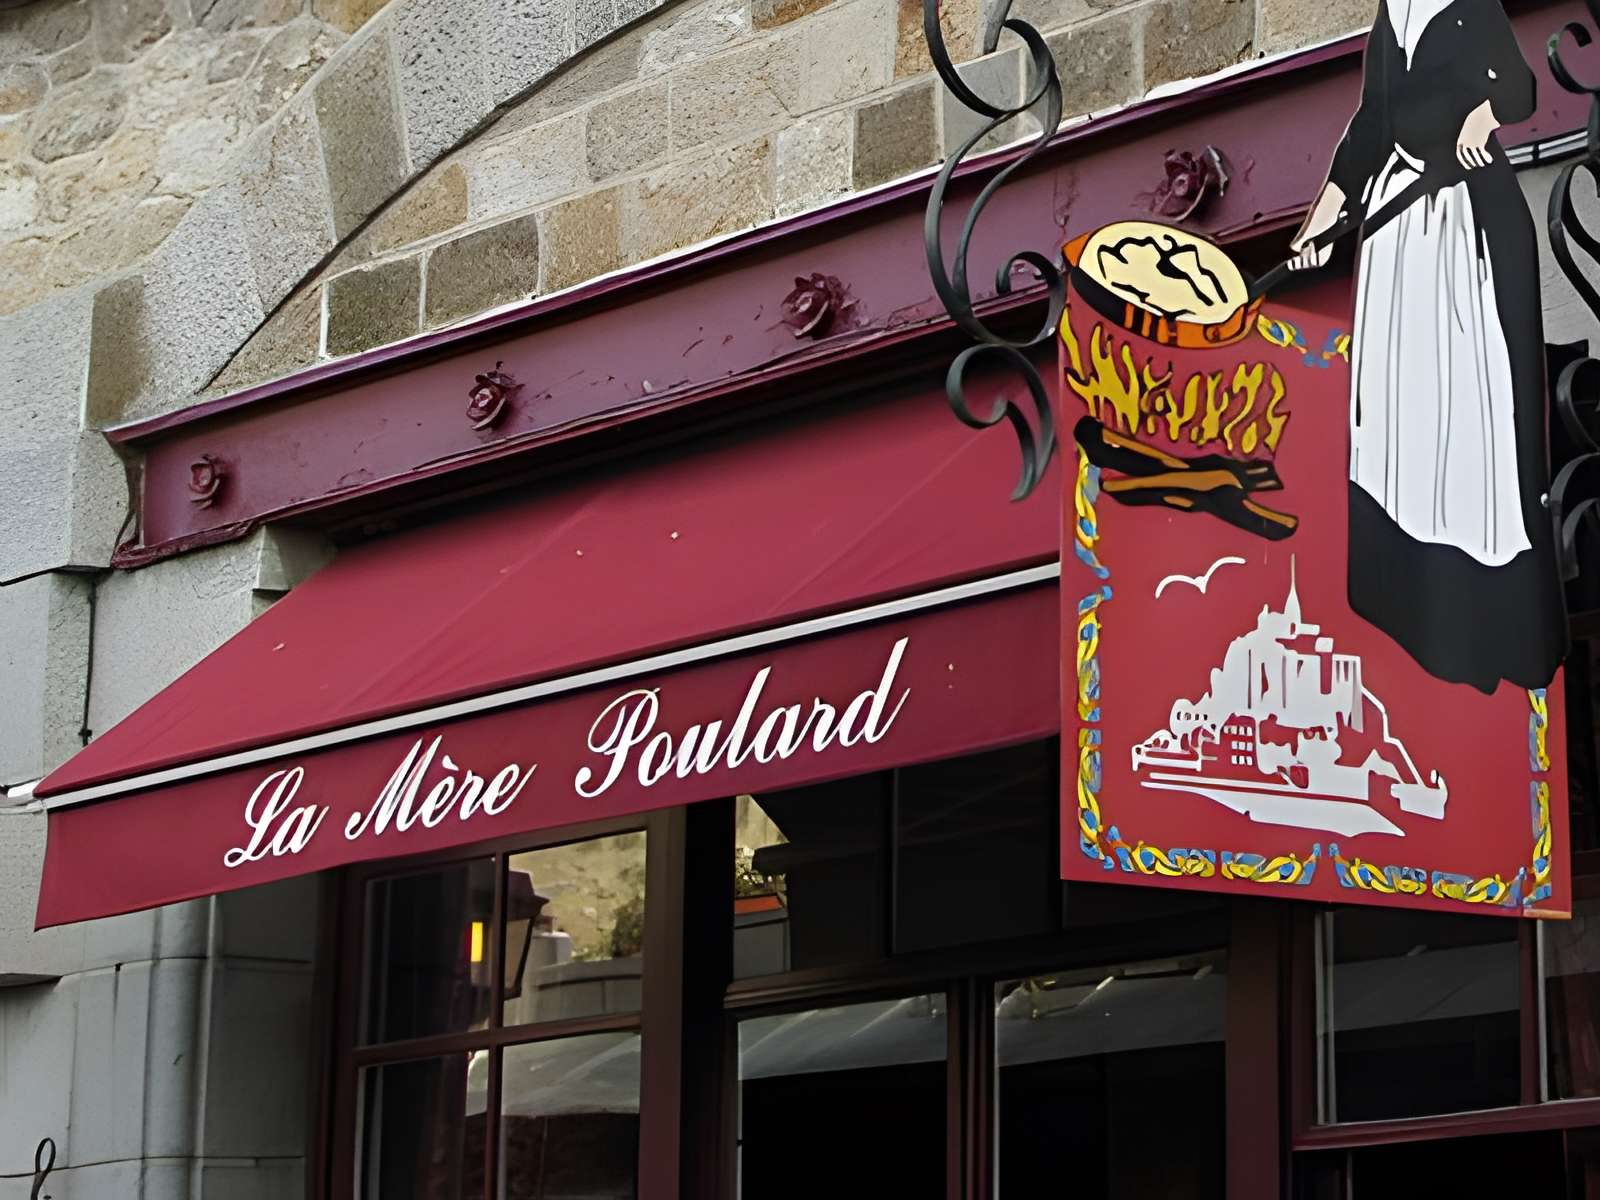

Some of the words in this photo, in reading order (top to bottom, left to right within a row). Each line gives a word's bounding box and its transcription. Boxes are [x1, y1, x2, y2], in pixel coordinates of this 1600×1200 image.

[222, 765, 330, 869] La
[344, 733, 538, 841] Mère
[574, 636, 912, 799] Poulard
